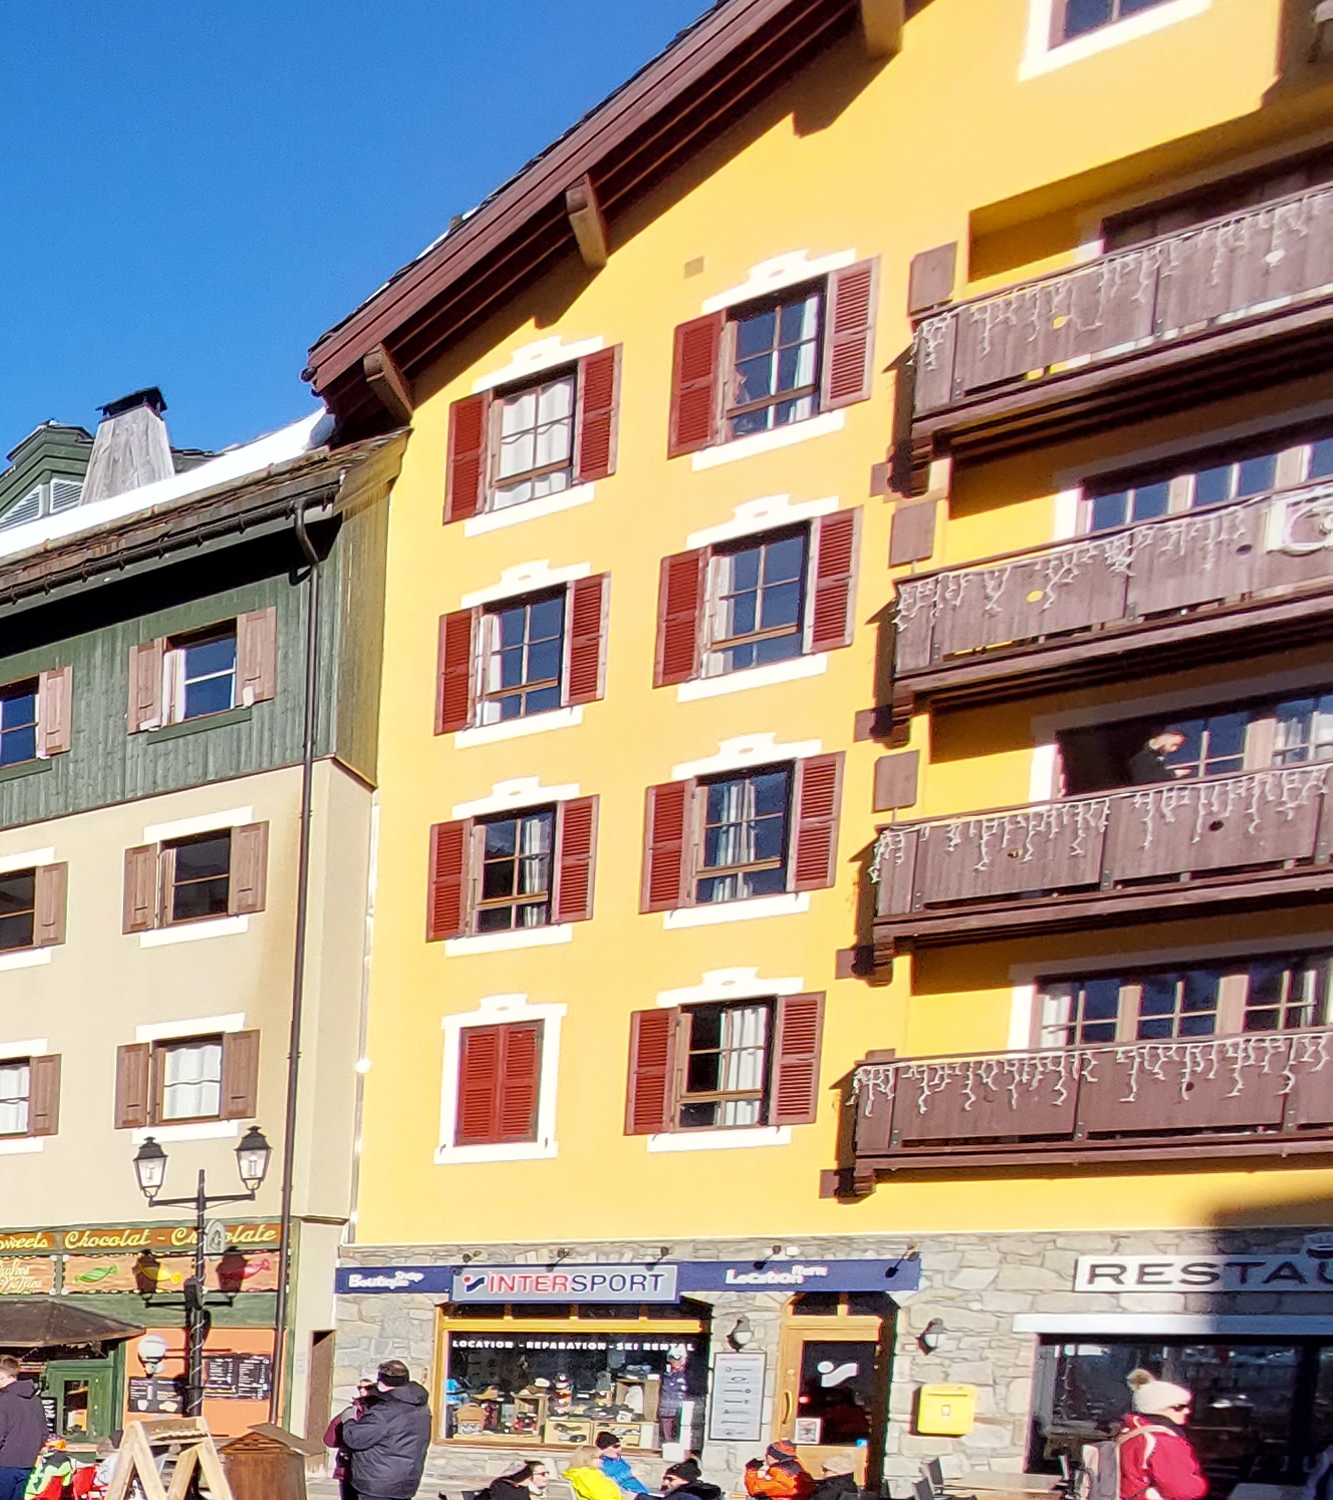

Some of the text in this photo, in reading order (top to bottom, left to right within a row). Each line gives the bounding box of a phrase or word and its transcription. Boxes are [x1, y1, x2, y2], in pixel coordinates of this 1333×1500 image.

[64, 1229, 151, 1249] Chocolat
[171, 1224, 278, 1246] Cholate
[348, 1273, 410, 1290] Boutique
[487, 1273, 666, 1294] INTERSPORT
[725, 1268, 804, 1284] Location
[452, 1340, 514, 1349] LOCATION
[526, 1341, 606, 1350] REPARATION
[616, 1342, 639, 1350] SKI
[643, 1342, 695, 1351] RENTAL
